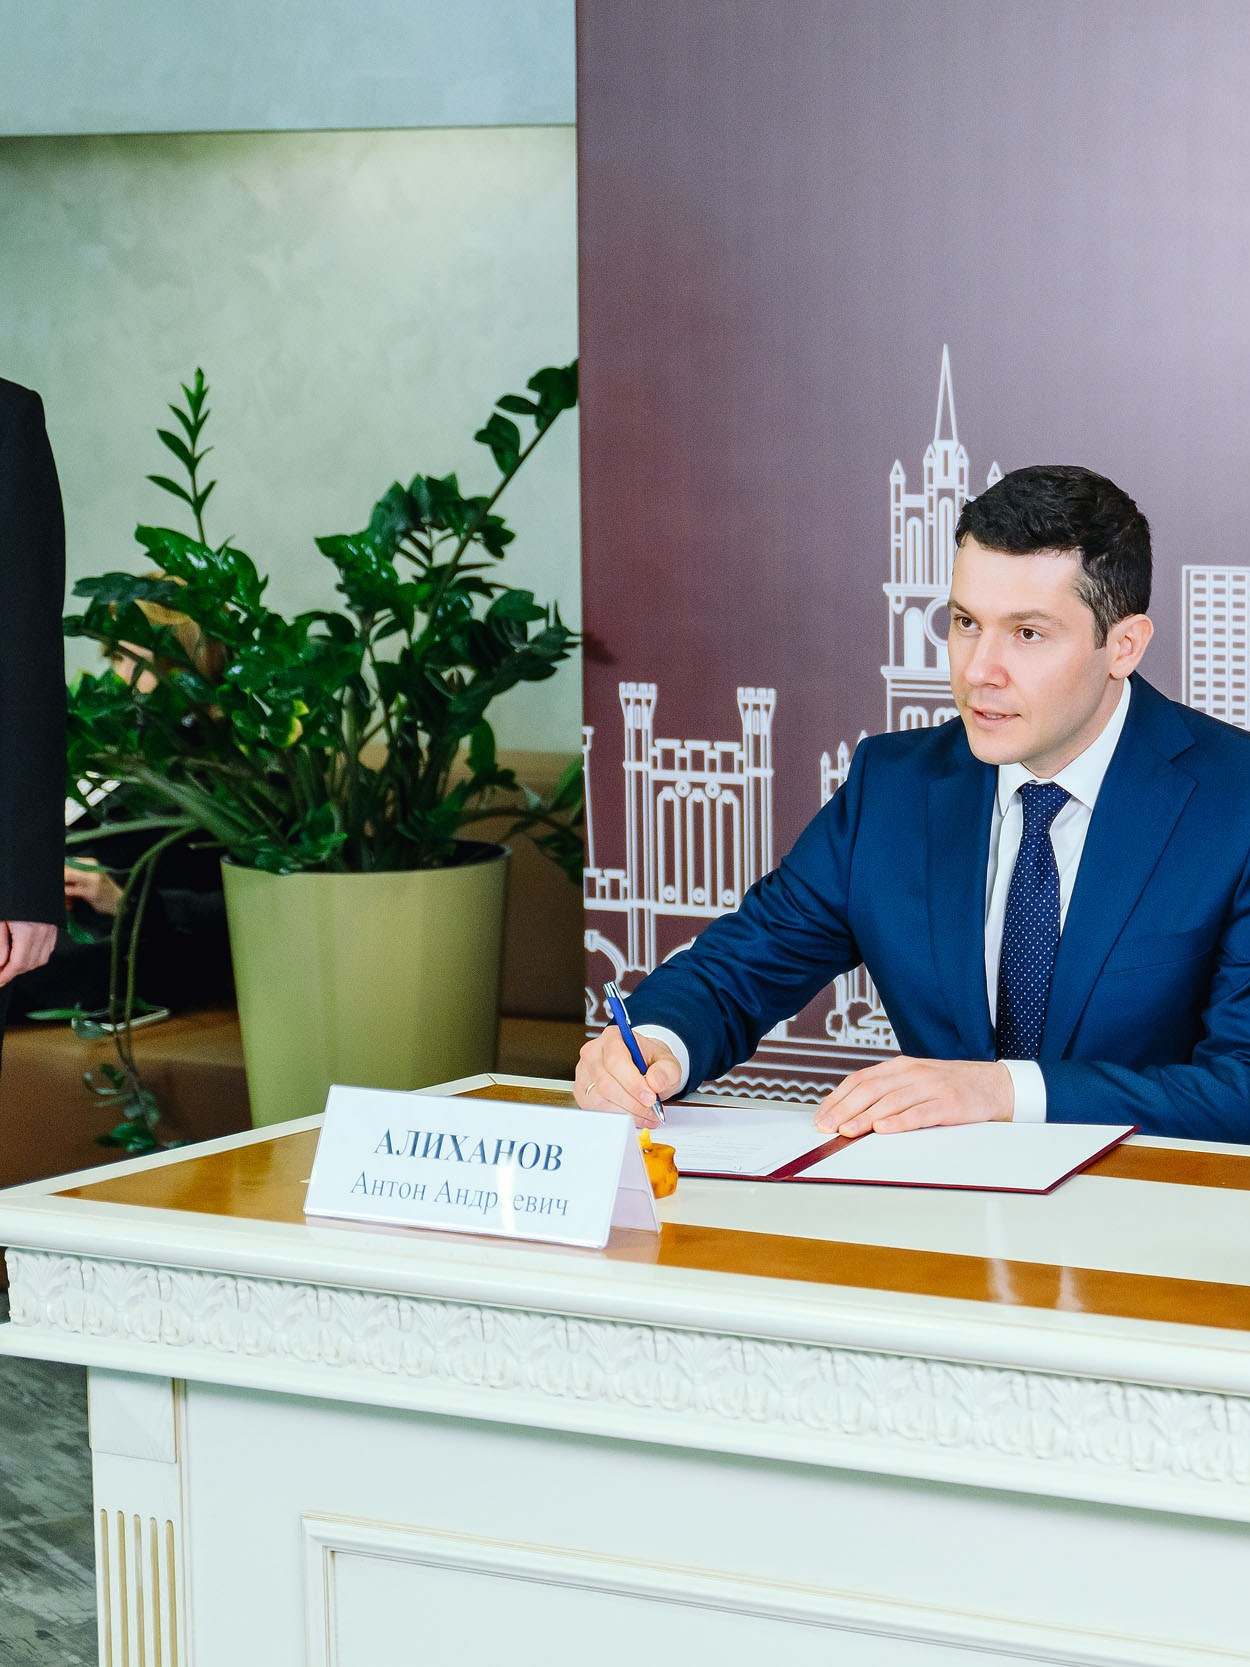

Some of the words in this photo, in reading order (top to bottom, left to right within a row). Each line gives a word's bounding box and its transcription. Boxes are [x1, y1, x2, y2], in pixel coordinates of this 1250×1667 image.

[374, 1129, 563, 1171] АЛИХАНОВ
[351, 1171, 427, 1201] Антон
[434, 1180, 568, 1215] Андревич
